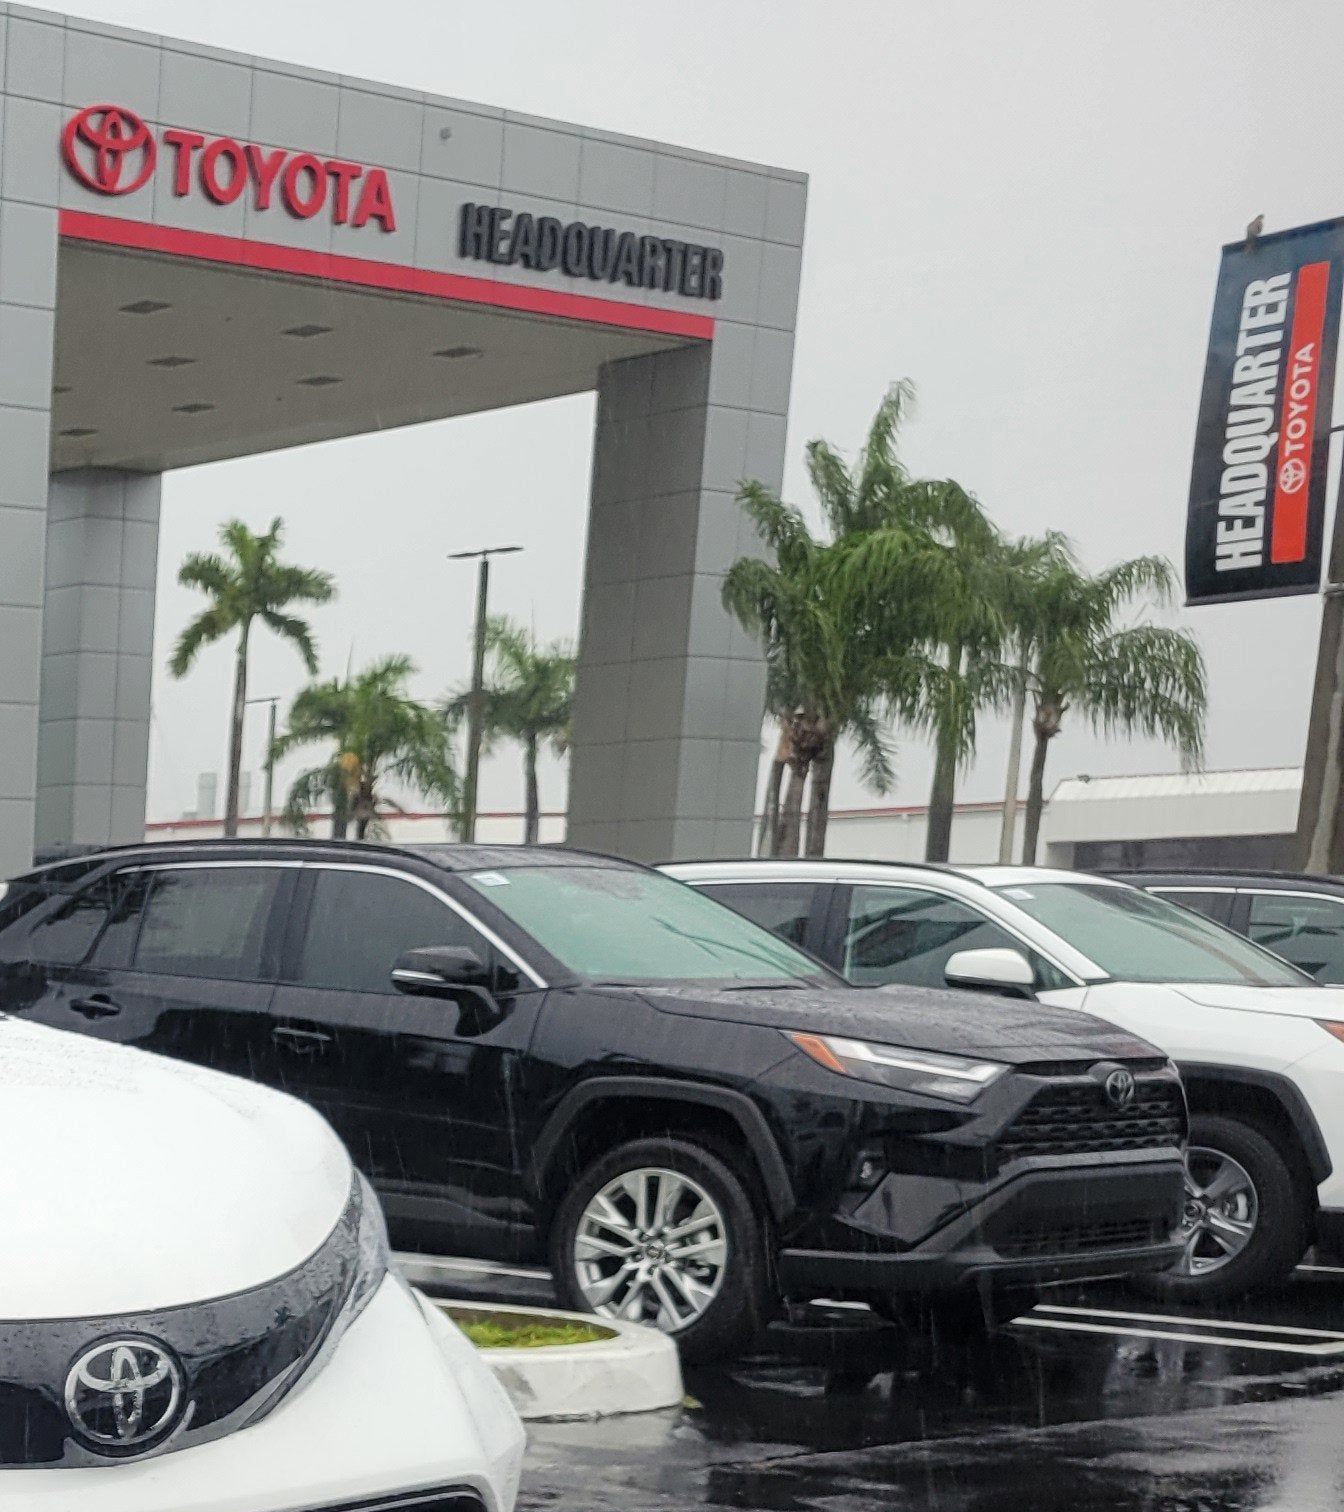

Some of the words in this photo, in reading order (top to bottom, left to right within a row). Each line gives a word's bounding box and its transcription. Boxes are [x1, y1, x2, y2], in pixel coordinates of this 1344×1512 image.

[164, 129, 397, 233] TOYOTA
[457, 201, 725, 301] HEADQUARTER
[1215, 271, 1293, 573] HEADQUARTER
[1283, 342, 1316, 458] TOYOTA
